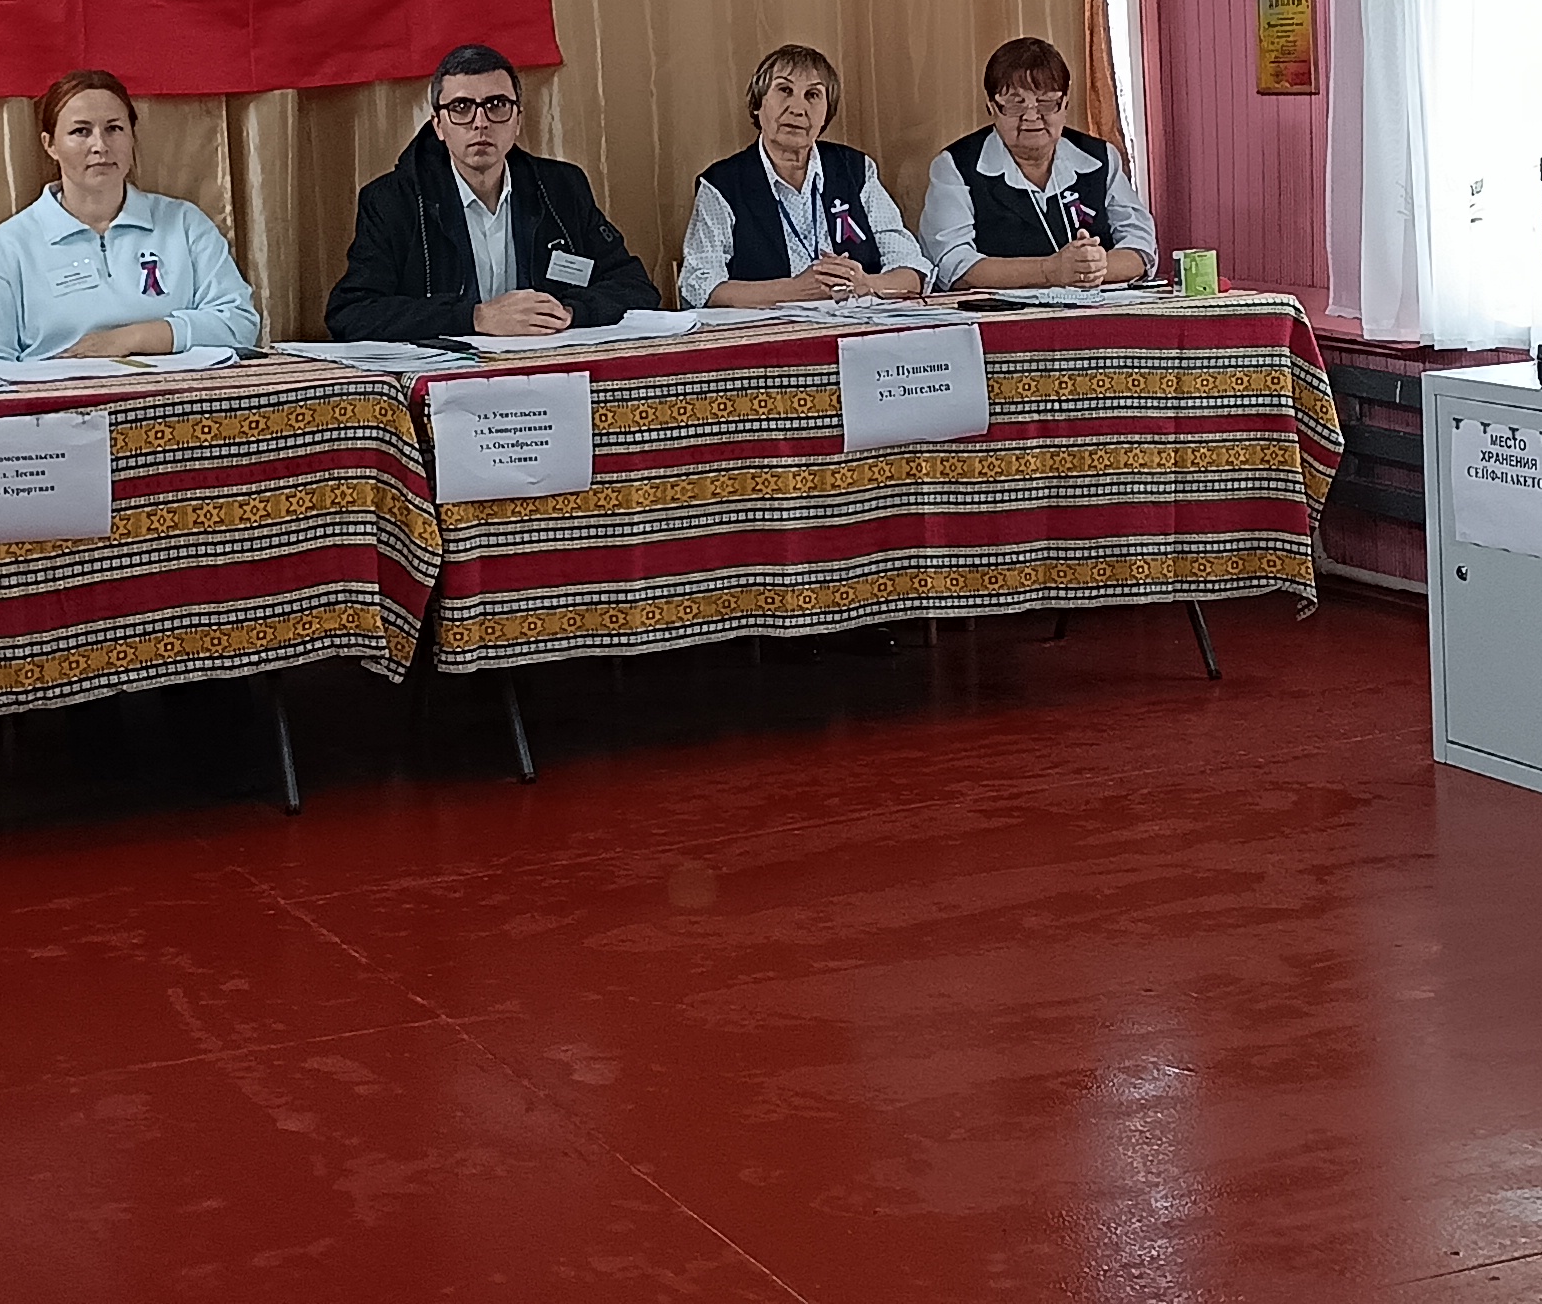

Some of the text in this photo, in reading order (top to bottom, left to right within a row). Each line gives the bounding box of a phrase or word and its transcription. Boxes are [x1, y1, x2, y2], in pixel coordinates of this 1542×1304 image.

[876, 363, 949, 382] ул. Пушкина
[878, 383, 951, 402] ул. Энгельса
[1490, 433, 1527, 452] МЕСТО
[1480, 449, 1538, 471] ХРАНЕНИЯ
[3, 485, 55, 496] Курортная
